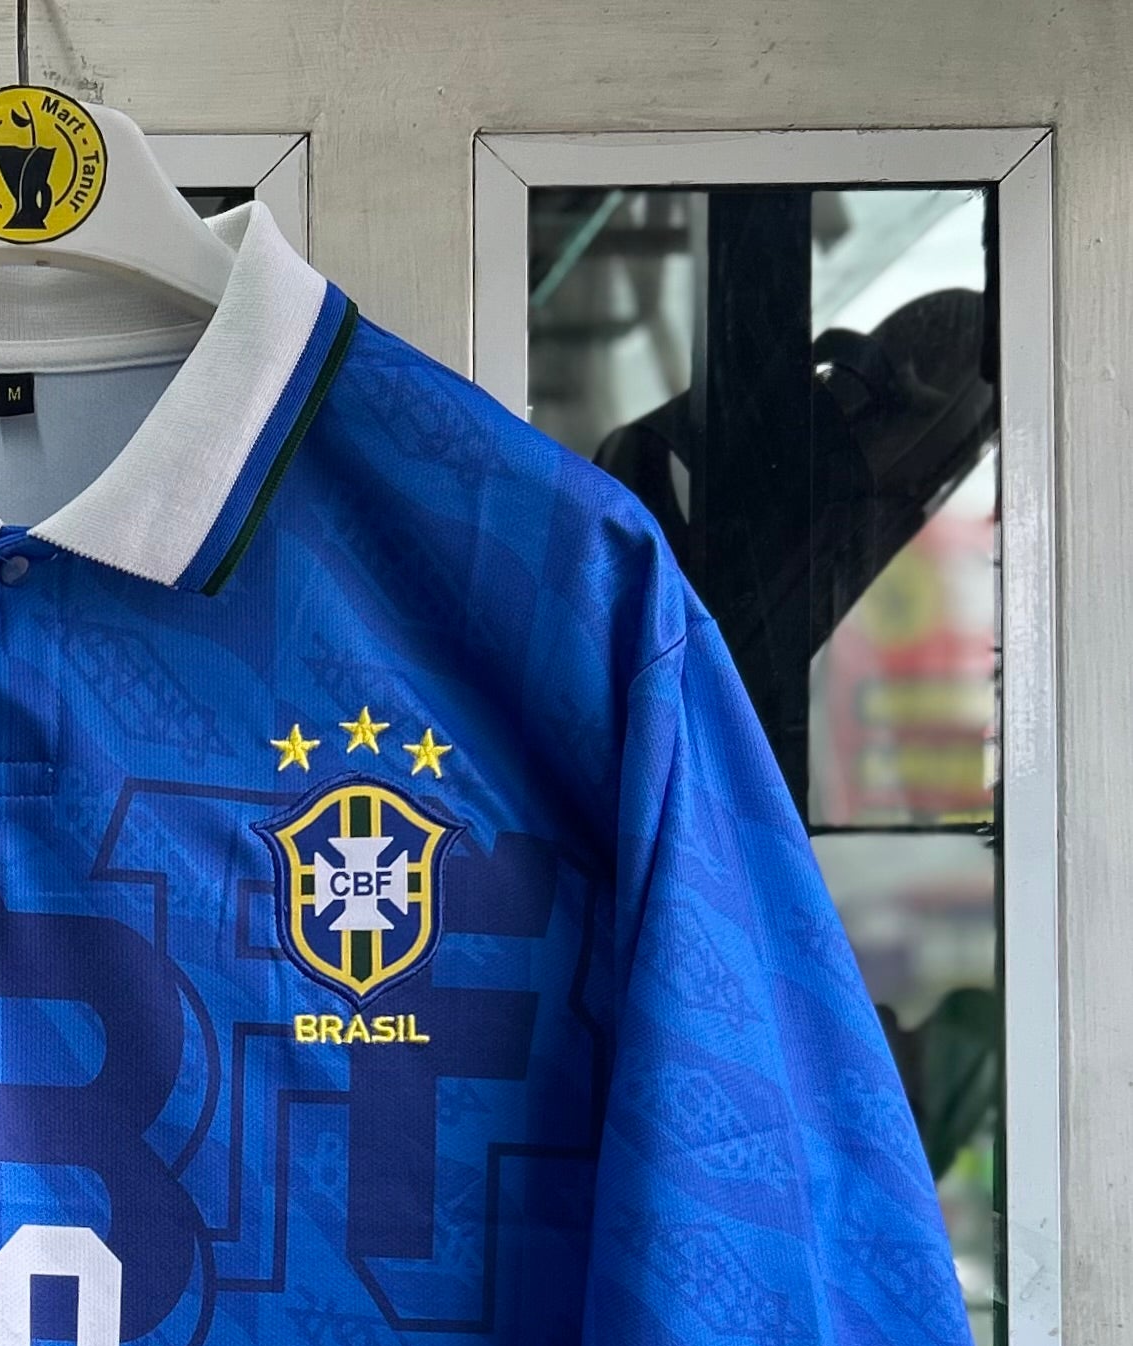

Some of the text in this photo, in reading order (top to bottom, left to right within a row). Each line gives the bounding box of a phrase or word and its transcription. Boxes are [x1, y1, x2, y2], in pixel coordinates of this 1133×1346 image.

[41, 95, 86, 134] Mart
[72, 150, 100, 213] Tanur
[7, 386, 21, 401] M
[329, 870, 392, 897] CBF
[294, 1014, 430, 1045] BRASIL
